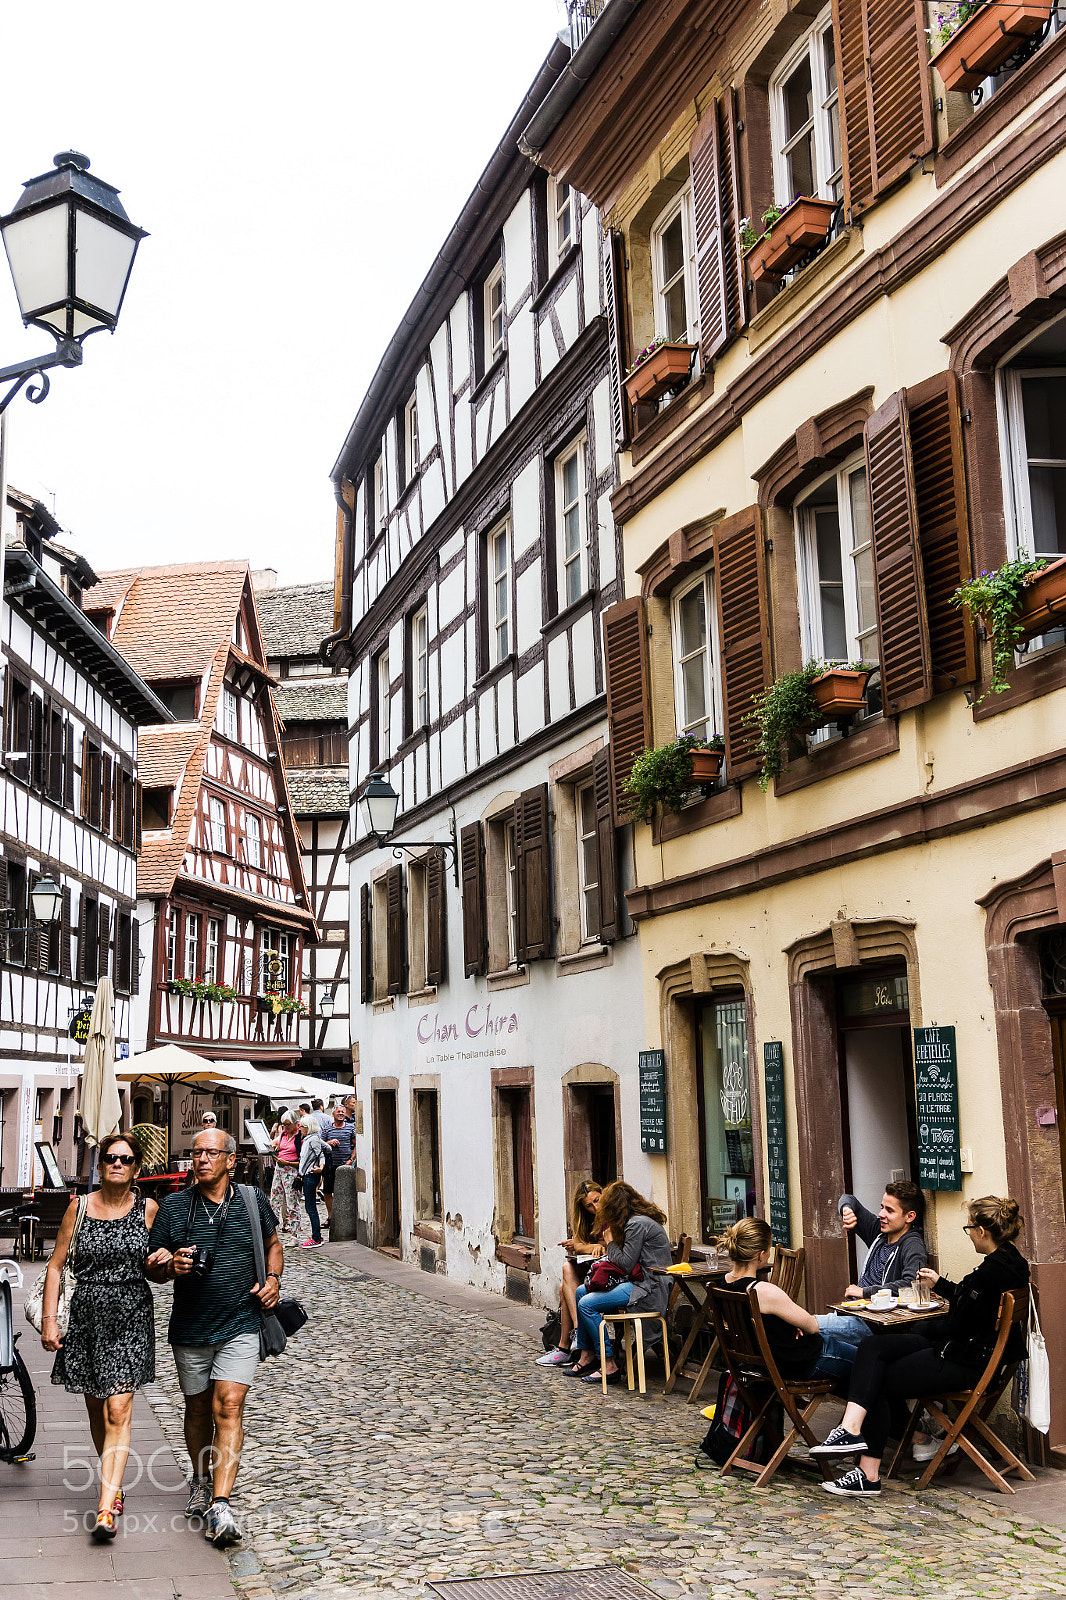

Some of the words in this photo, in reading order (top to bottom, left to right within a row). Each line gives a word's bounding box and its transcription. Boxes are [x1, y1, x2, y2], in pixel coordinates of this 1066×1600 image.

[417, 1013, 459, 1045] Chan
[465, 1002, 519, 1038] Chira
[436, 1054, 455, 1063] Table
